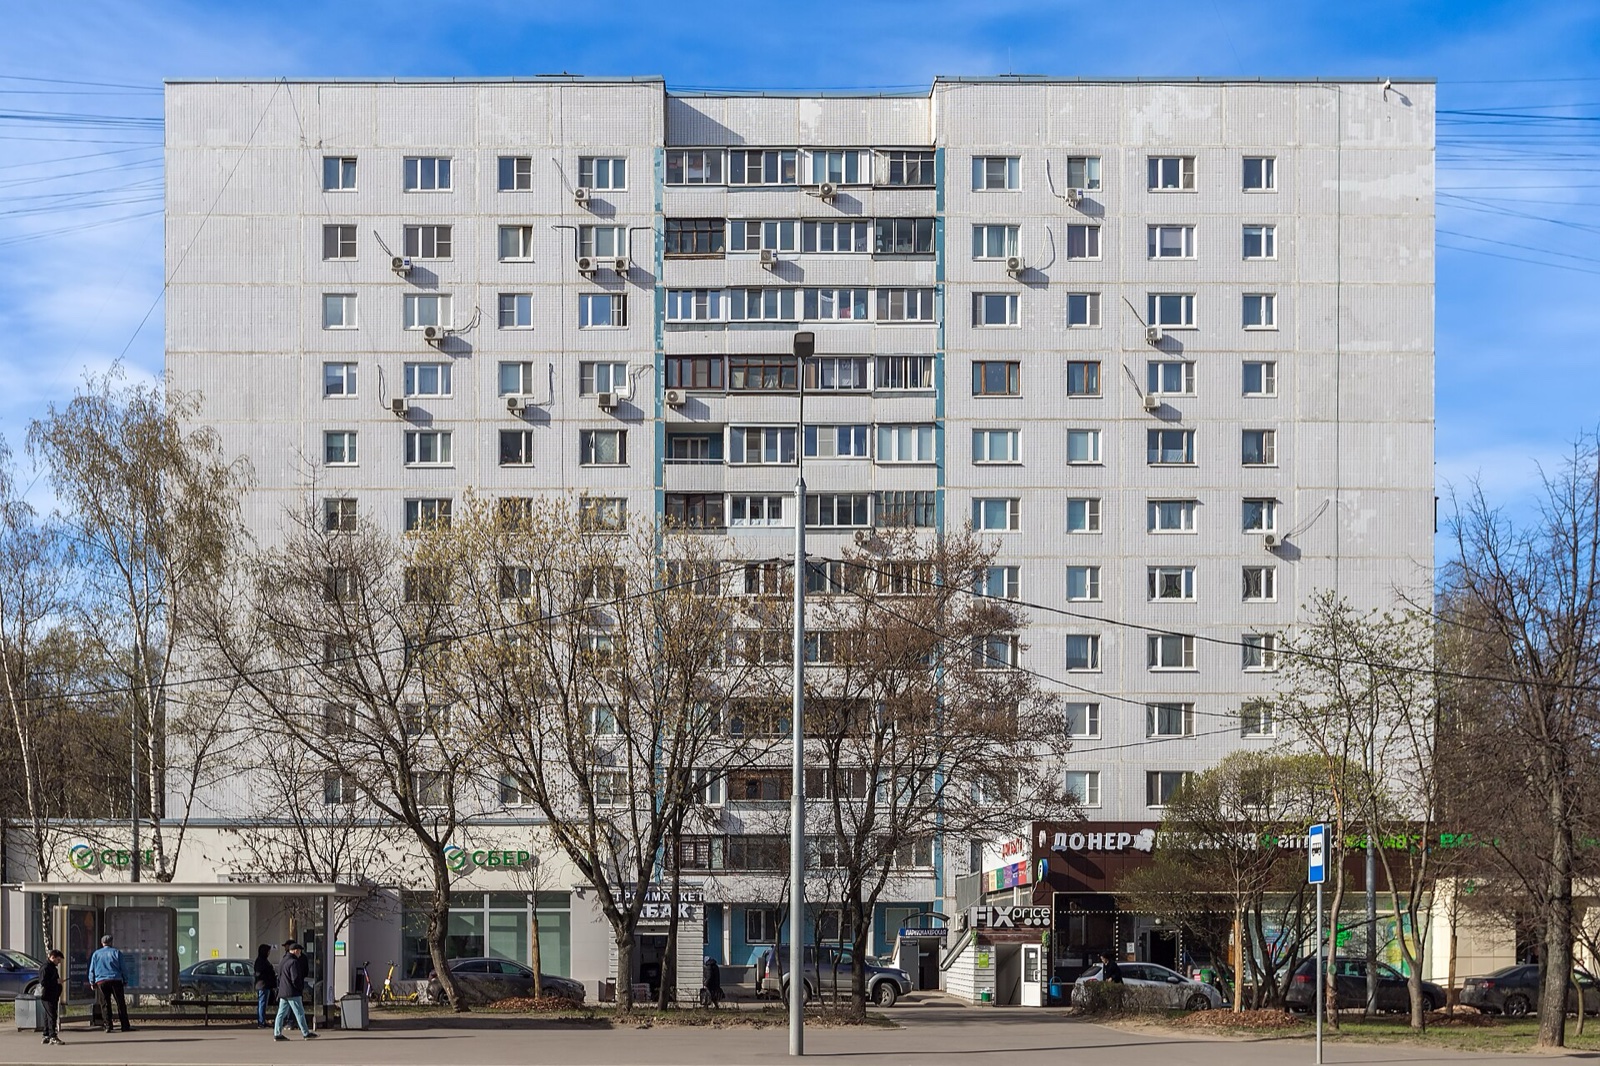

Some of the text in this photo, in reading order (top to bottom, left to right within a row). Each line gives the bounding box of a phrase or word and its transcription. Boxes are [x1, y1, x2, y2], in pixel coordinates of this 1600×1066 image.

[1051, 832, 1131, 851] ДОНЕР
[471, 850, 530, 866] СБЕР
[1012, 907, 1051, 920] price
